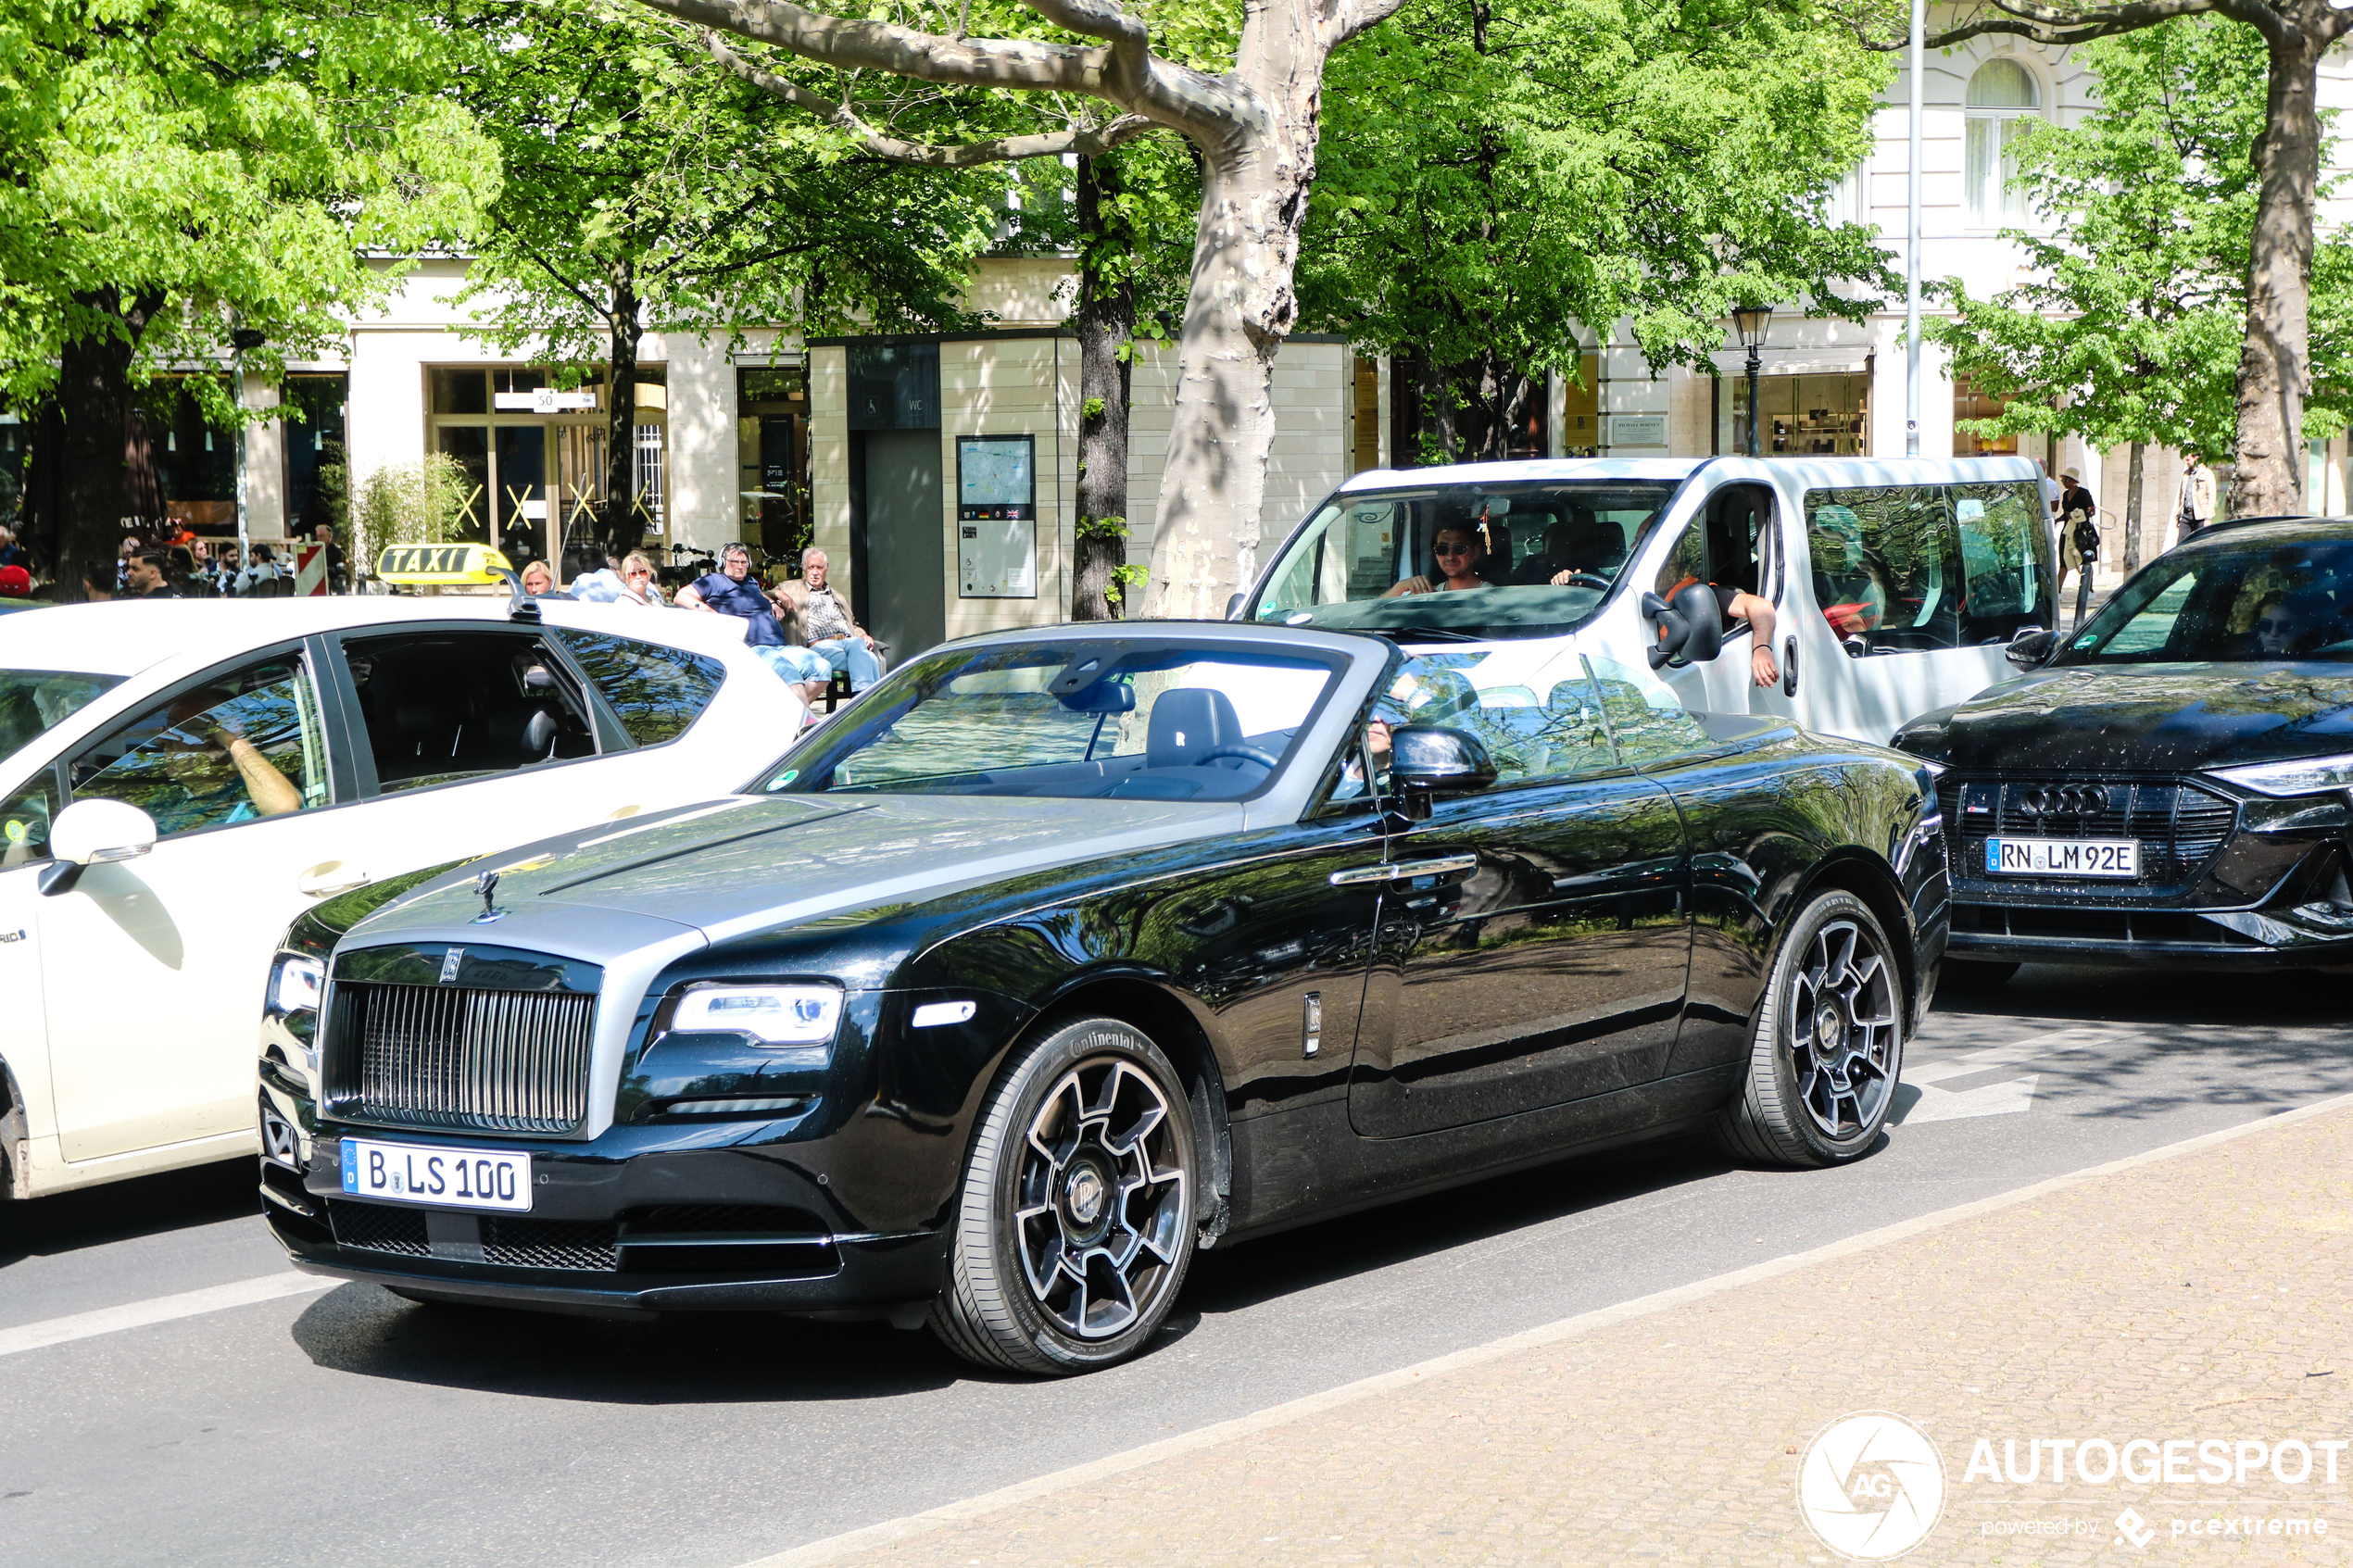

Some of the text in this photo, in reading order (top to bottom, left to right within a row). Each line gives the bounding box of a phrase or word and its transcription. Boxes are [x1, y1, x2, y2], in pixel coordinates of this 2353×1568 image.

[538, 395, 553, 407] 50
[909, 400, 923, 411] WC
[392, 548, 459, 572] TAXI
[2002, 844, 2132, 871] RN LM 92E
[1069, 1032, 1134, 1058] Continental
[347, 1172, 355, 1184] D
[370, 1150, 515, 1201] B LS 100
